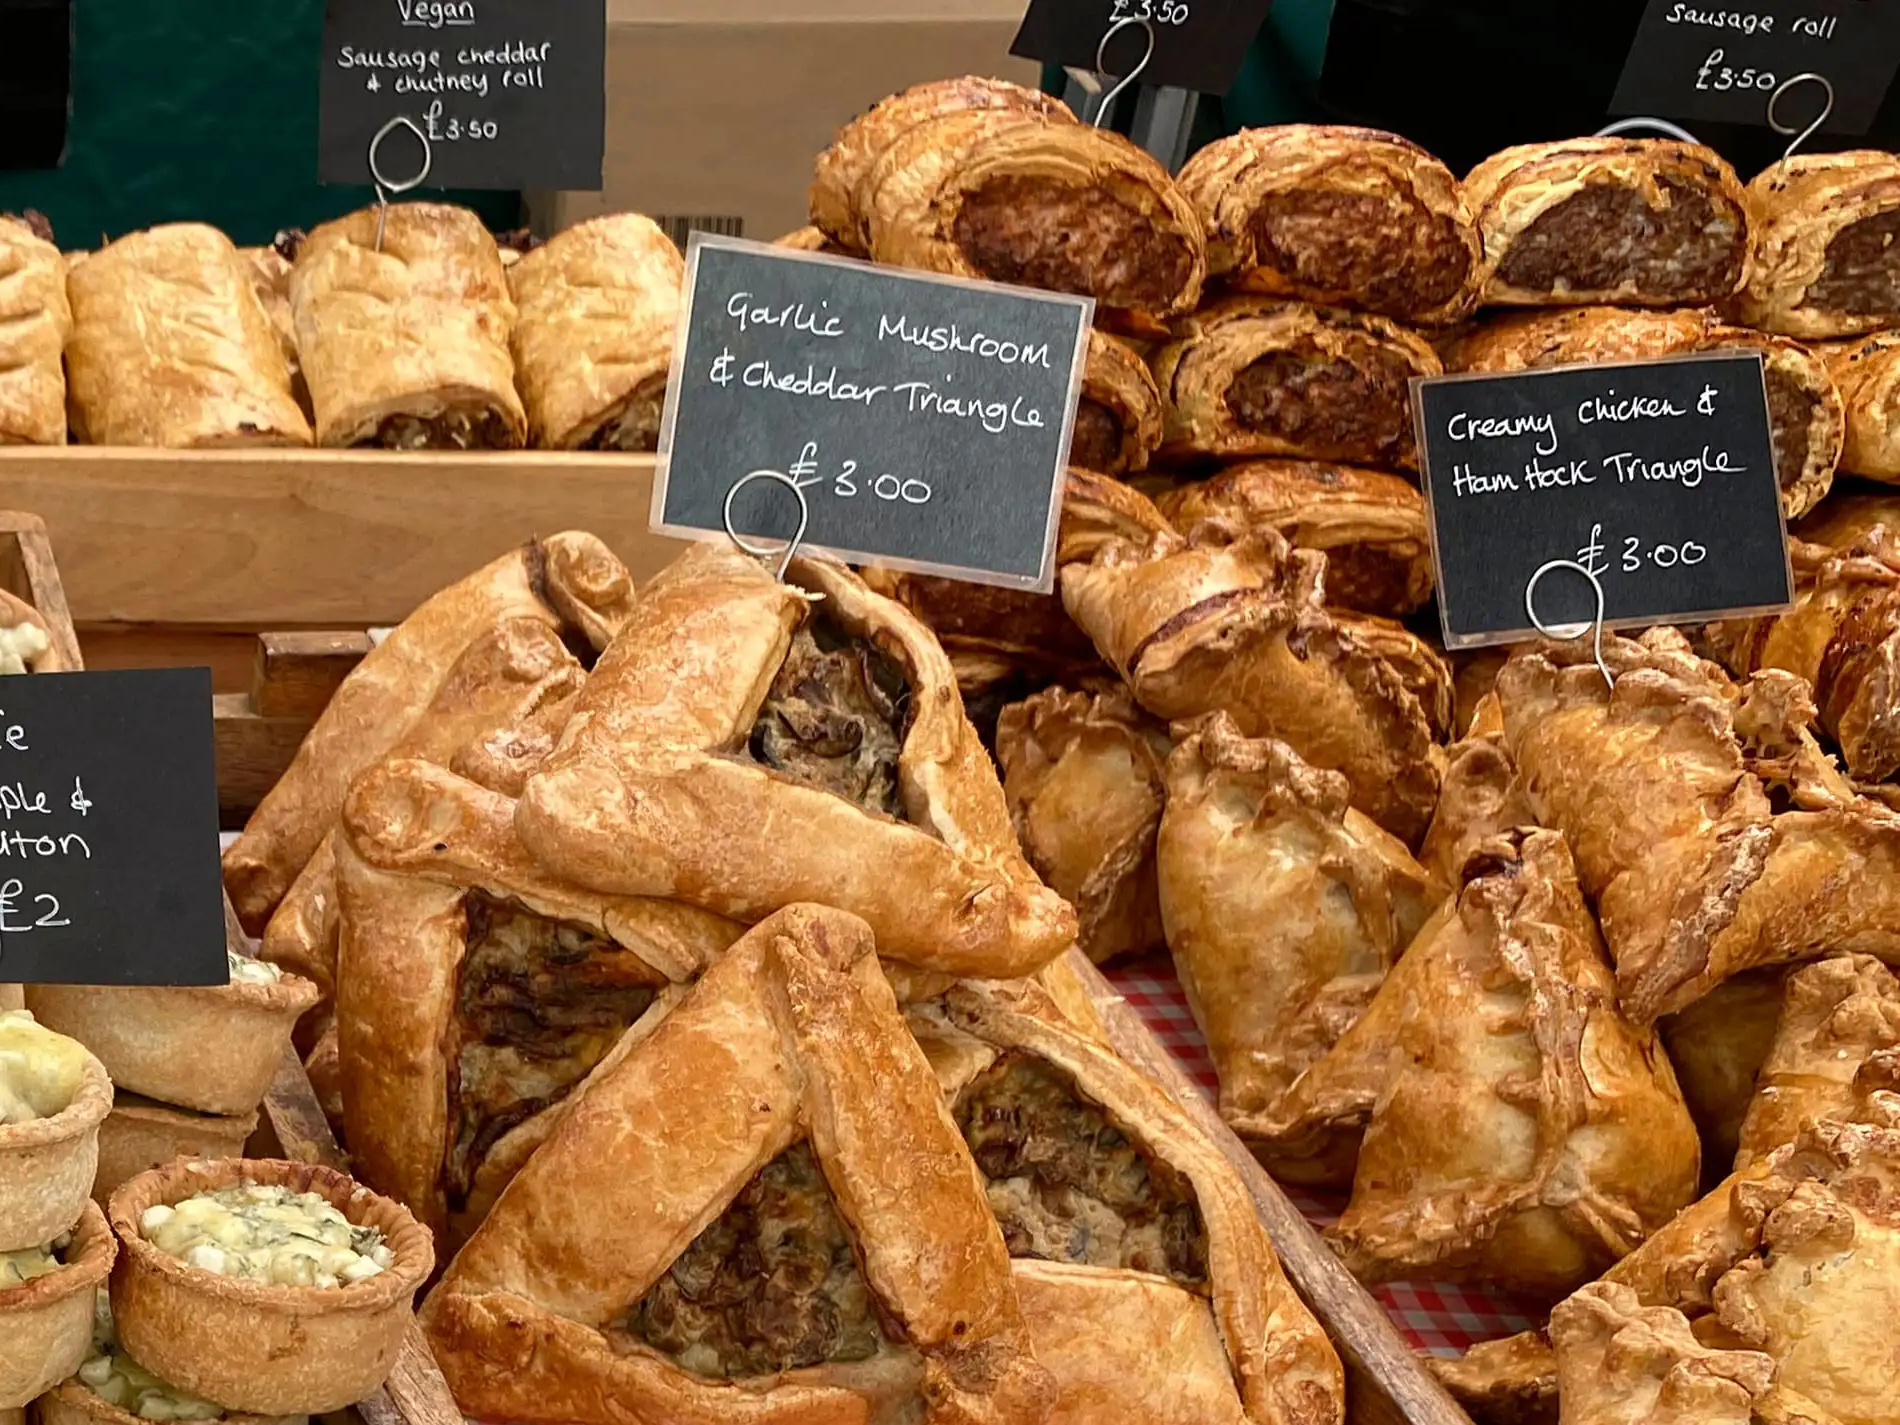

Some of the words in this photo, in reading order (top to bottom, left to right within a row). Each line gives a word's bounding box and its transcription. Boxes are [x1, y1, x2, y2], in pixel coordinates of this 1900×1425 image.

[398, 0, 475, 29] Vegan
[1666, 2, 1774, 34] Sausage
[1792, 16, 1837, 39] roll
[337, 45, 440, 73] Sausage
[457, 40, 551, 65] cheddar
[395, 71, 488, 97] chutney
[502, 65, 543, 88] roll
[727, 291, 845, 337] Garlic
[878, 313, 1051, 369] Mushroom
[709, 346, 736, 389] &
[742, 360, 888, 407] Cheddar
[893, 373, 1045, 434] Triangle
[1447, 412, 1559, 456] Creamy
[1696, 384, 1718, 417] &
[1453, 463, 1519, 496] Ham
[1524, 458, 1597, 493] Hock
[1602, 444, 1748, 487] Triangle
[70, 775, 93, 817] &
